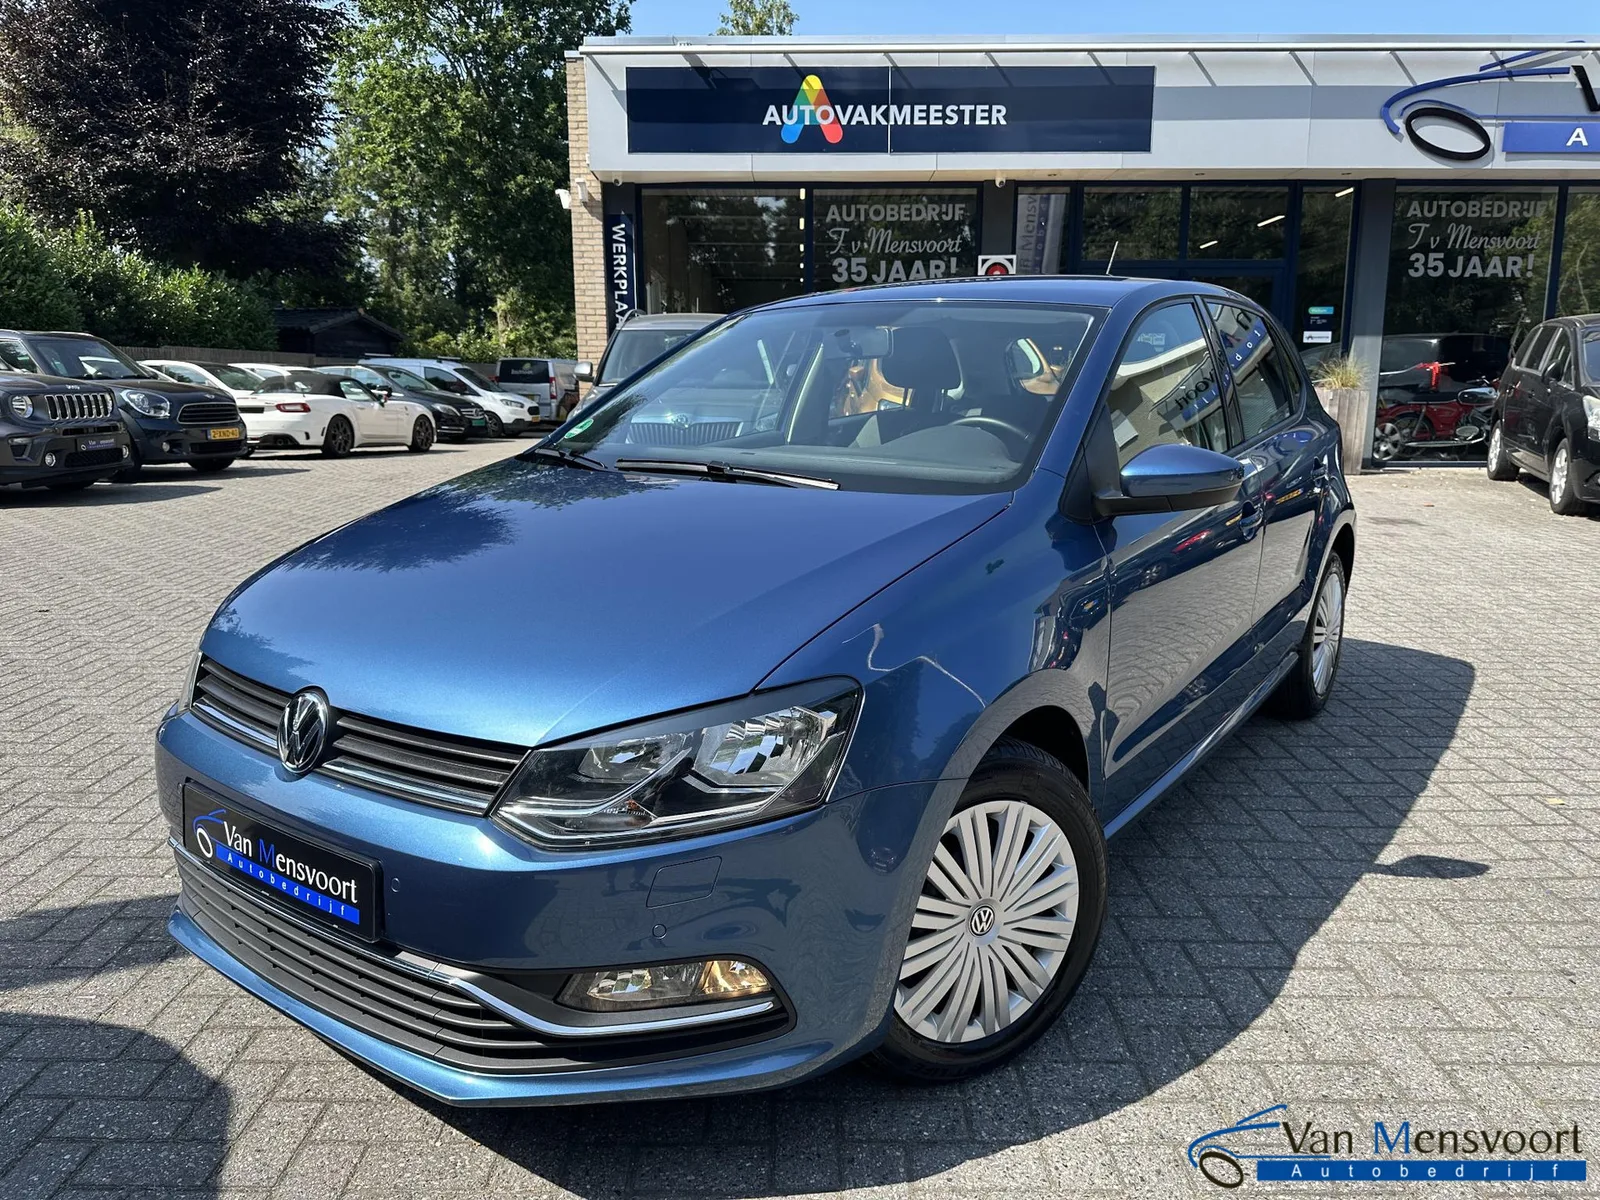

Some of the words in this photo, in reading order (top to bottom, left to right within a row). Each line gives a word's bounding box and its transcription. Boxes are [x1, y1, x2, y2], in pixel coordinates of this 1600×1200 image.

[762, 104, 1007, 126] AUTOVAKMEESTER
[826, 203, 965, 222] AUTOBEDRIJF
[1406, 200, 1548, 218] AUTOBEDRIJF
[851, 240, 861, 253] v
[867, 226, 962, 254] Mensvoort
[1430, 235, 1440, 249] v
[1447, 222, 1542, 249] Mensvoort
[832, 257, 868, 283] 35
[871, 257, 957, 284] JAAR!
[1408, 253, 1444, 278] 35
[1448, 254, 1534, 278] JAAR!
[223, 821, 252, 857] Van
[259, 838, 358, 904] Mensvoort
[227, 852, 345, 916] Autobedrijf
